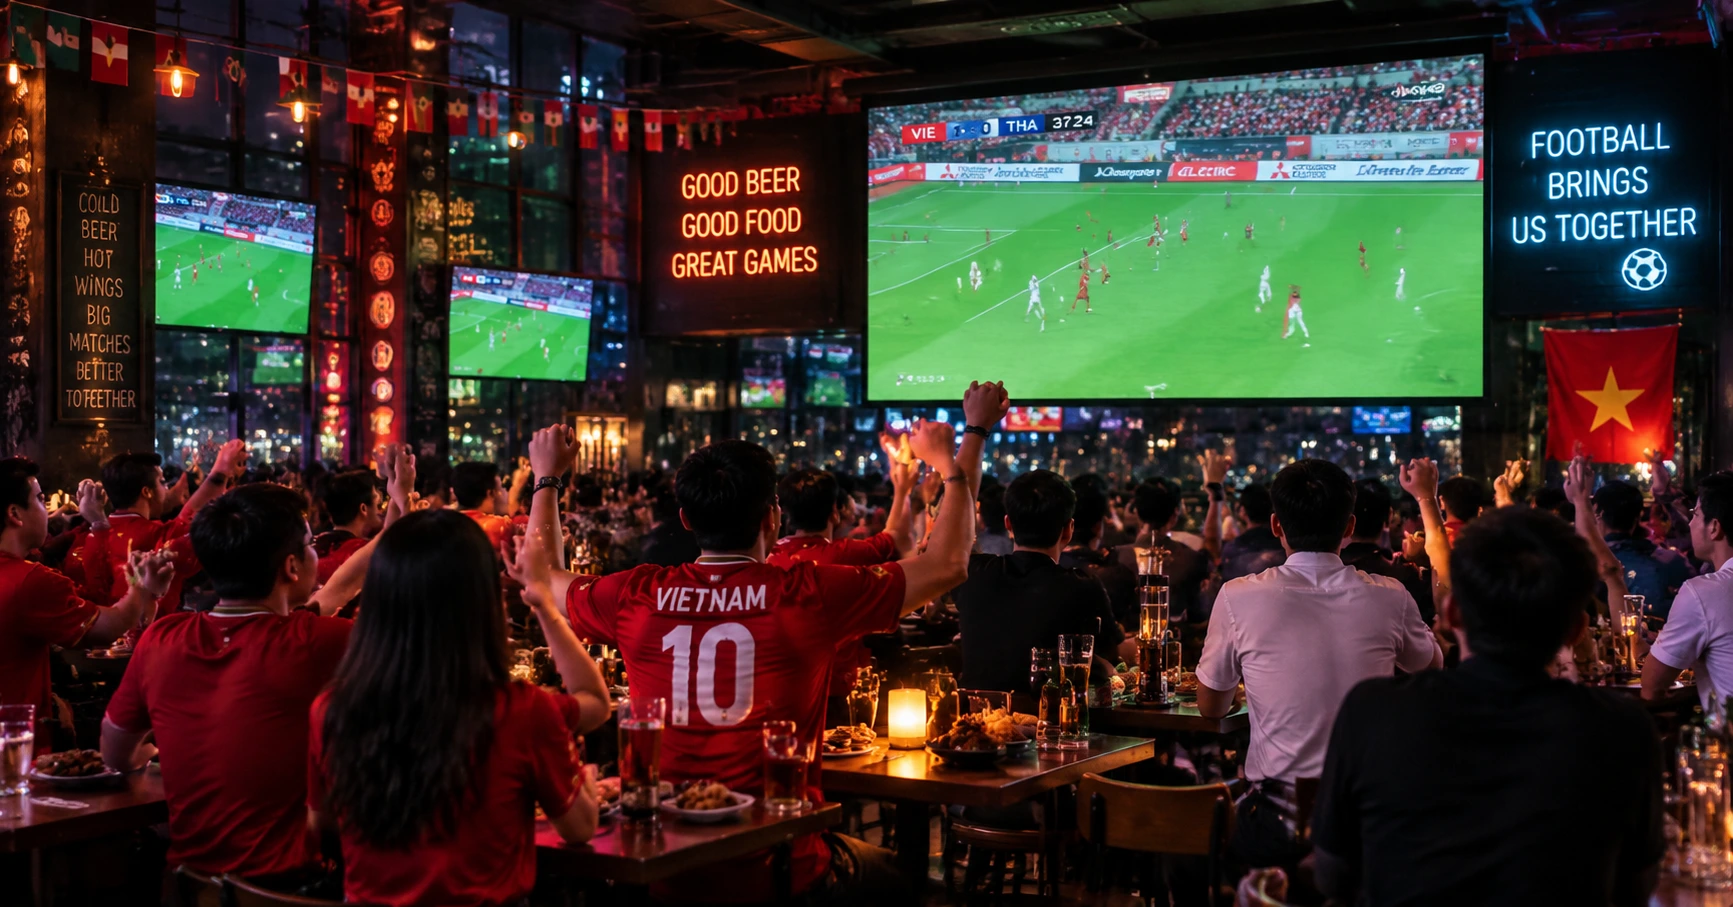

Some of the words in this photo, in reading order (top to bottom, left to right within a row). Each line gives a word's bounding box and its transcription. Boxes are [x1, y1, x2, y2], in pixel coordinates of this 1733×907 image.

[911, 126, 936, 140] VIE
[1006, 118, 1038, 133] THA
[1531, 122, 1670, 159] FOOTBALL
[681, 171, 739, 200] GOOD
[745, 166, 801, 195] BEER
[1548, 166, 1649, 200] BRINGS
[81, 219, 118, 242] BEER
[681, 210, 739, 239] GOOD
[745, 206, 802, 235] FOOD
[1512, 215, 1547, 244] US
[1555, 207, 1697, 242] TOGETHER
[671, 250, 738, 279] GREAT
[743, 245, 818, 275] GAMES
[87, 304, 111, 326] BIG
[69, 332, 131, 355] MATCHES
[76, 359, 124, 382] BETTER
[656, 584, 767, 613] VIETNAM
[662, 622, 756, 727] 10
